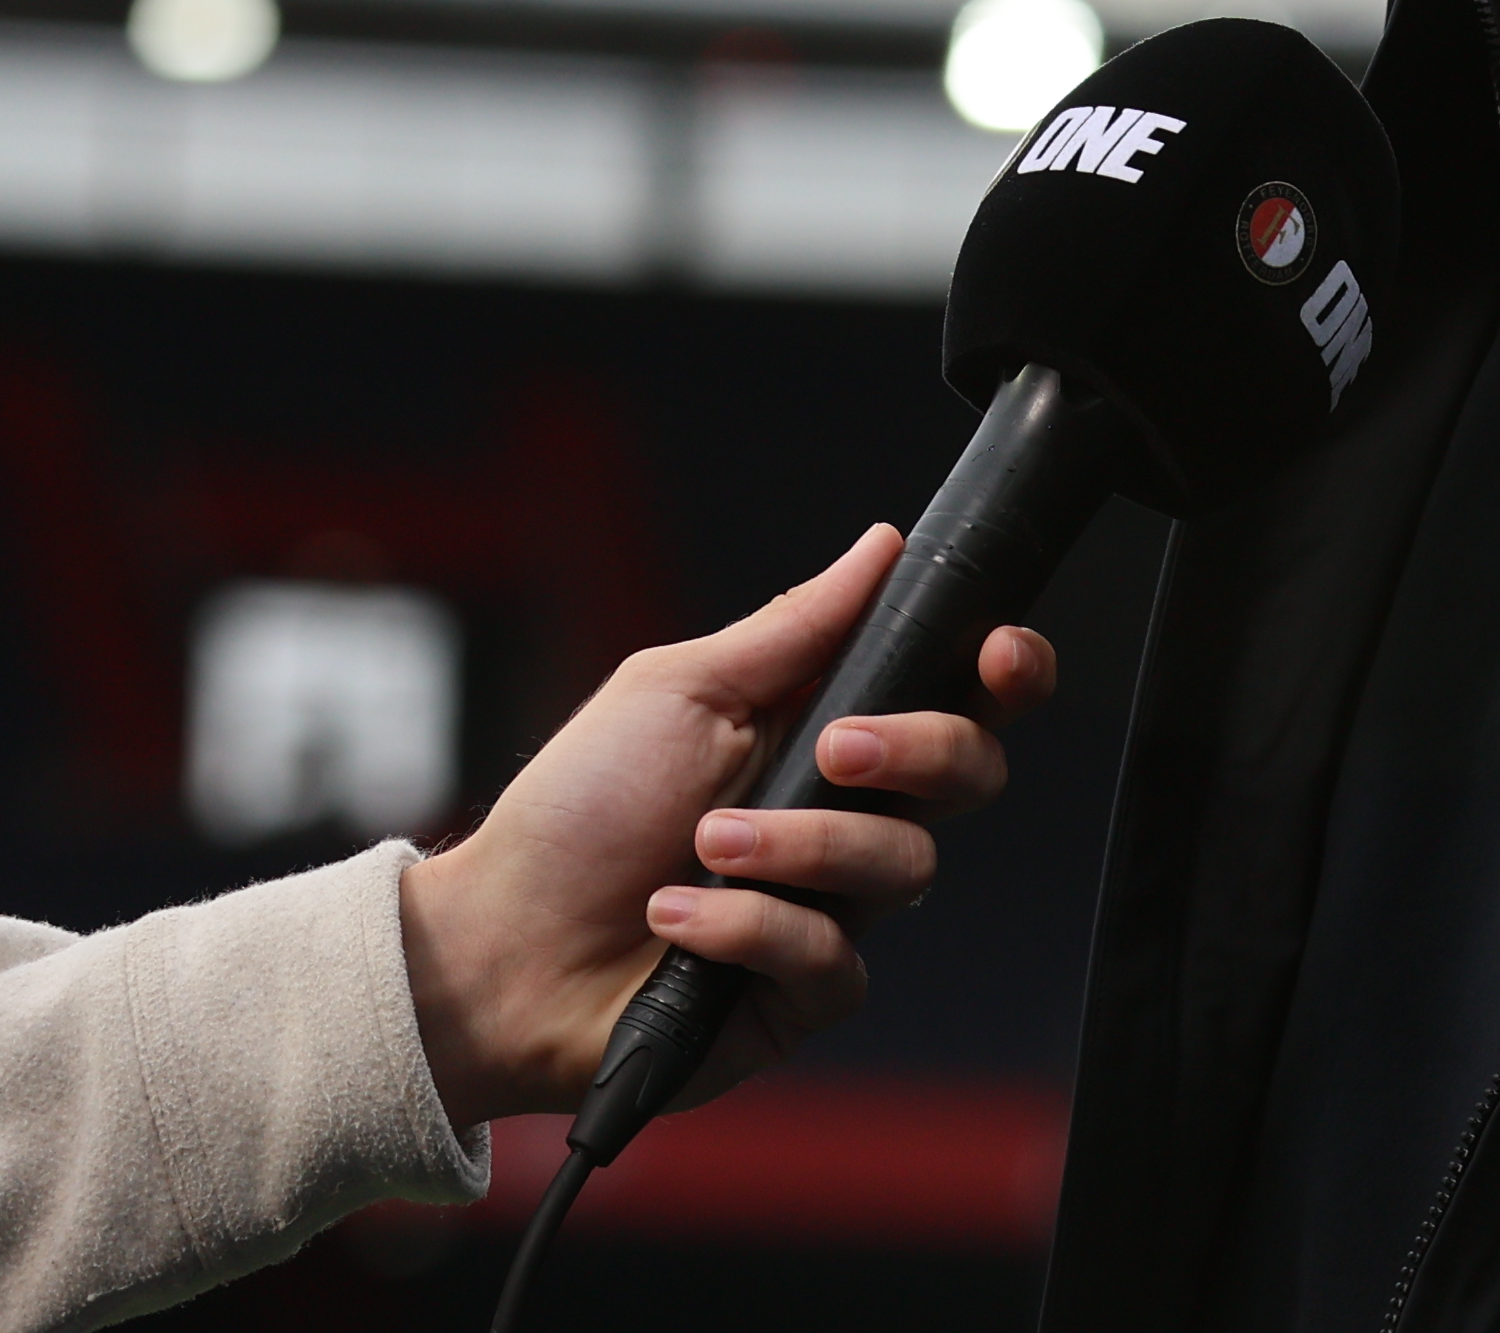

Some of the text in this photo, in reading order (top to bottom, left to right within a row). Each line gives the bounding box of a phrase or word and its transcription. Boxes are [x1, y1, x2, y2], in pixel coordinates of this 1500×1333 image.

[1017, 105, 1187, 184] ONE
[1259, 185, 1314, 247] FEYENOORD
[1239, 219, 1294, 280] ROTTERDAM
